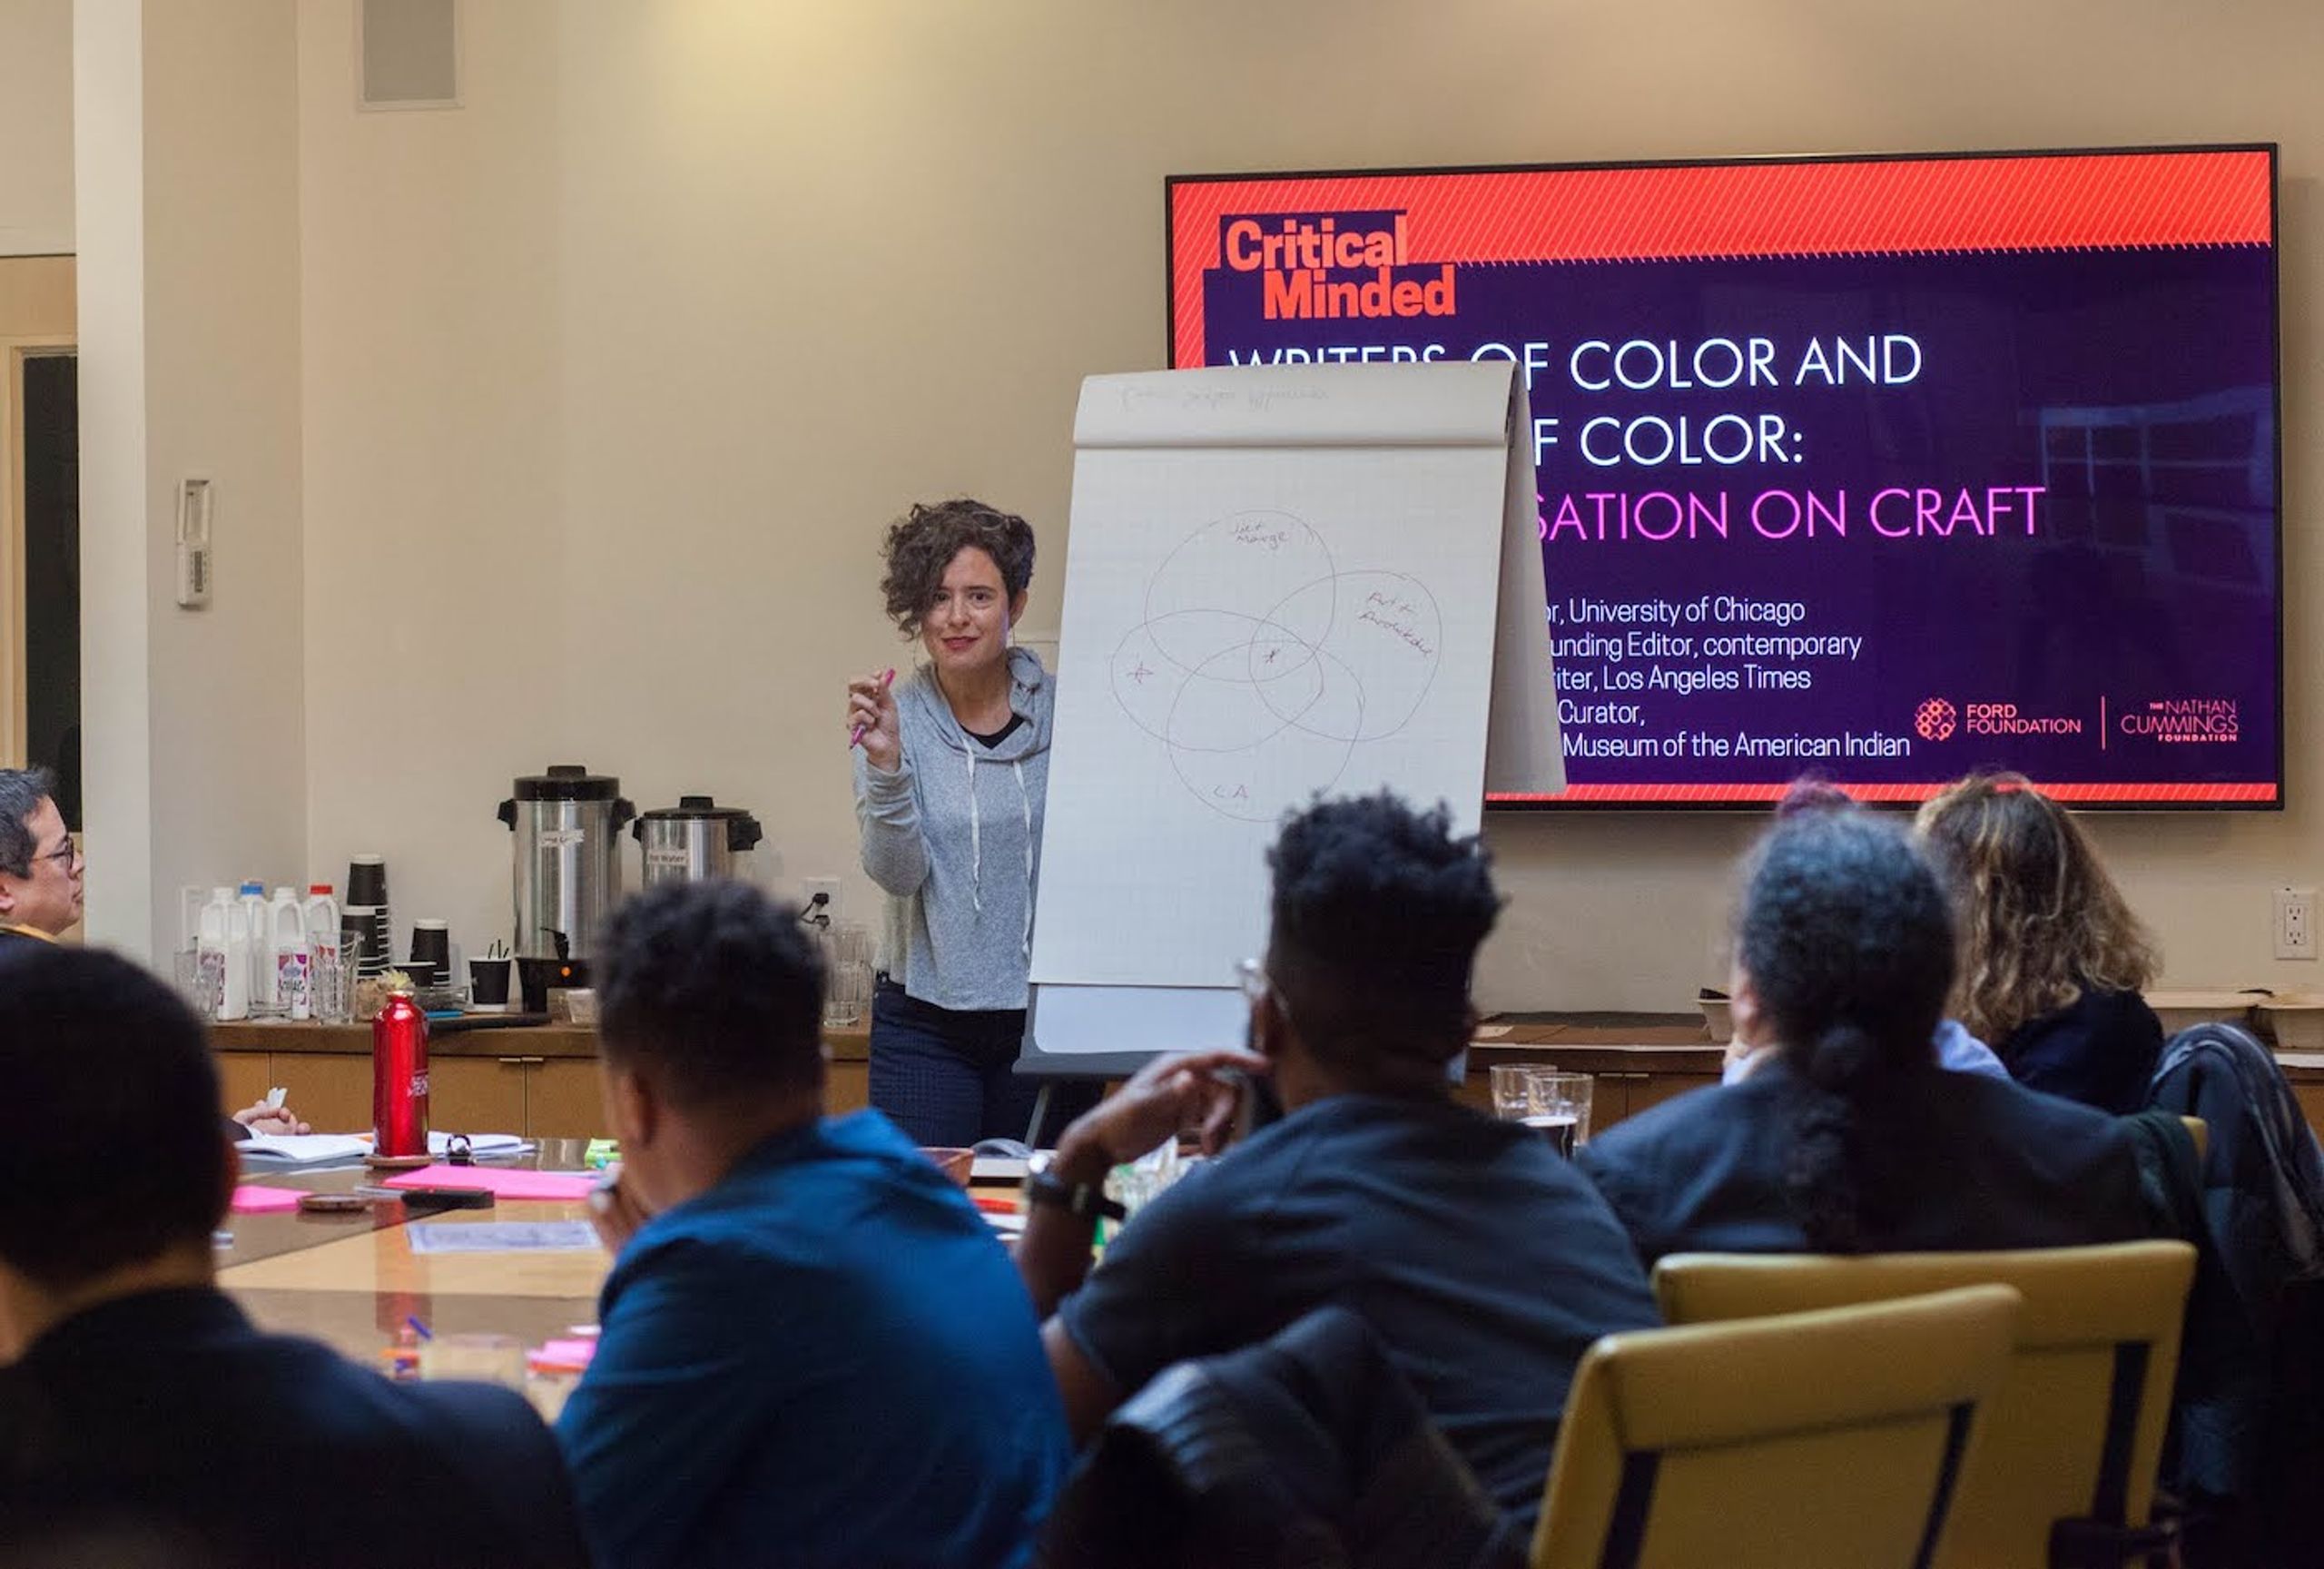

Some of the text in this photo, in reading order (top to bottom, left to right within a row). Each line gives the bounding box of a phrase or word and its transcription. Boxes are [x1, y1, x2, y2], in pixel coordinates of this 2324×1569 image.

[1226, 214, 1407, 271] Critical
[1263, 264, 1456, 320] Minded
[1570, 338, 1779, 390] COLOR
[1795, 334, 1922, 386] AND
[1533, 414, 1803, 467] F COLOR:
[1751, 489, 1846, 539] ON
[1869, 487, 2046, 538] CRAFT
[1569, 598, 1681, 627] University
[1685, 596, 1709, 623] of
[1714, 596, 1806, 627] Chicago
[1549, 630, 1863, 662] unding Editor, contemporary
[1552, 664, 1812, 696] iter, Los Angeles Times
[1558, 701, 1646, 726] Curator,
[1966, 704, 2017, 718] FORD
[2165, 698, 2236, 715] NATHAN
[1966, 718, 2082, 735] FOUNDATION
[2121, 714, 2239, 735] CUMMINGS
[2157, 733, 2238, 743] FOUNDATION
[1563, 730, 1910, 757] Museum of the American Indian
